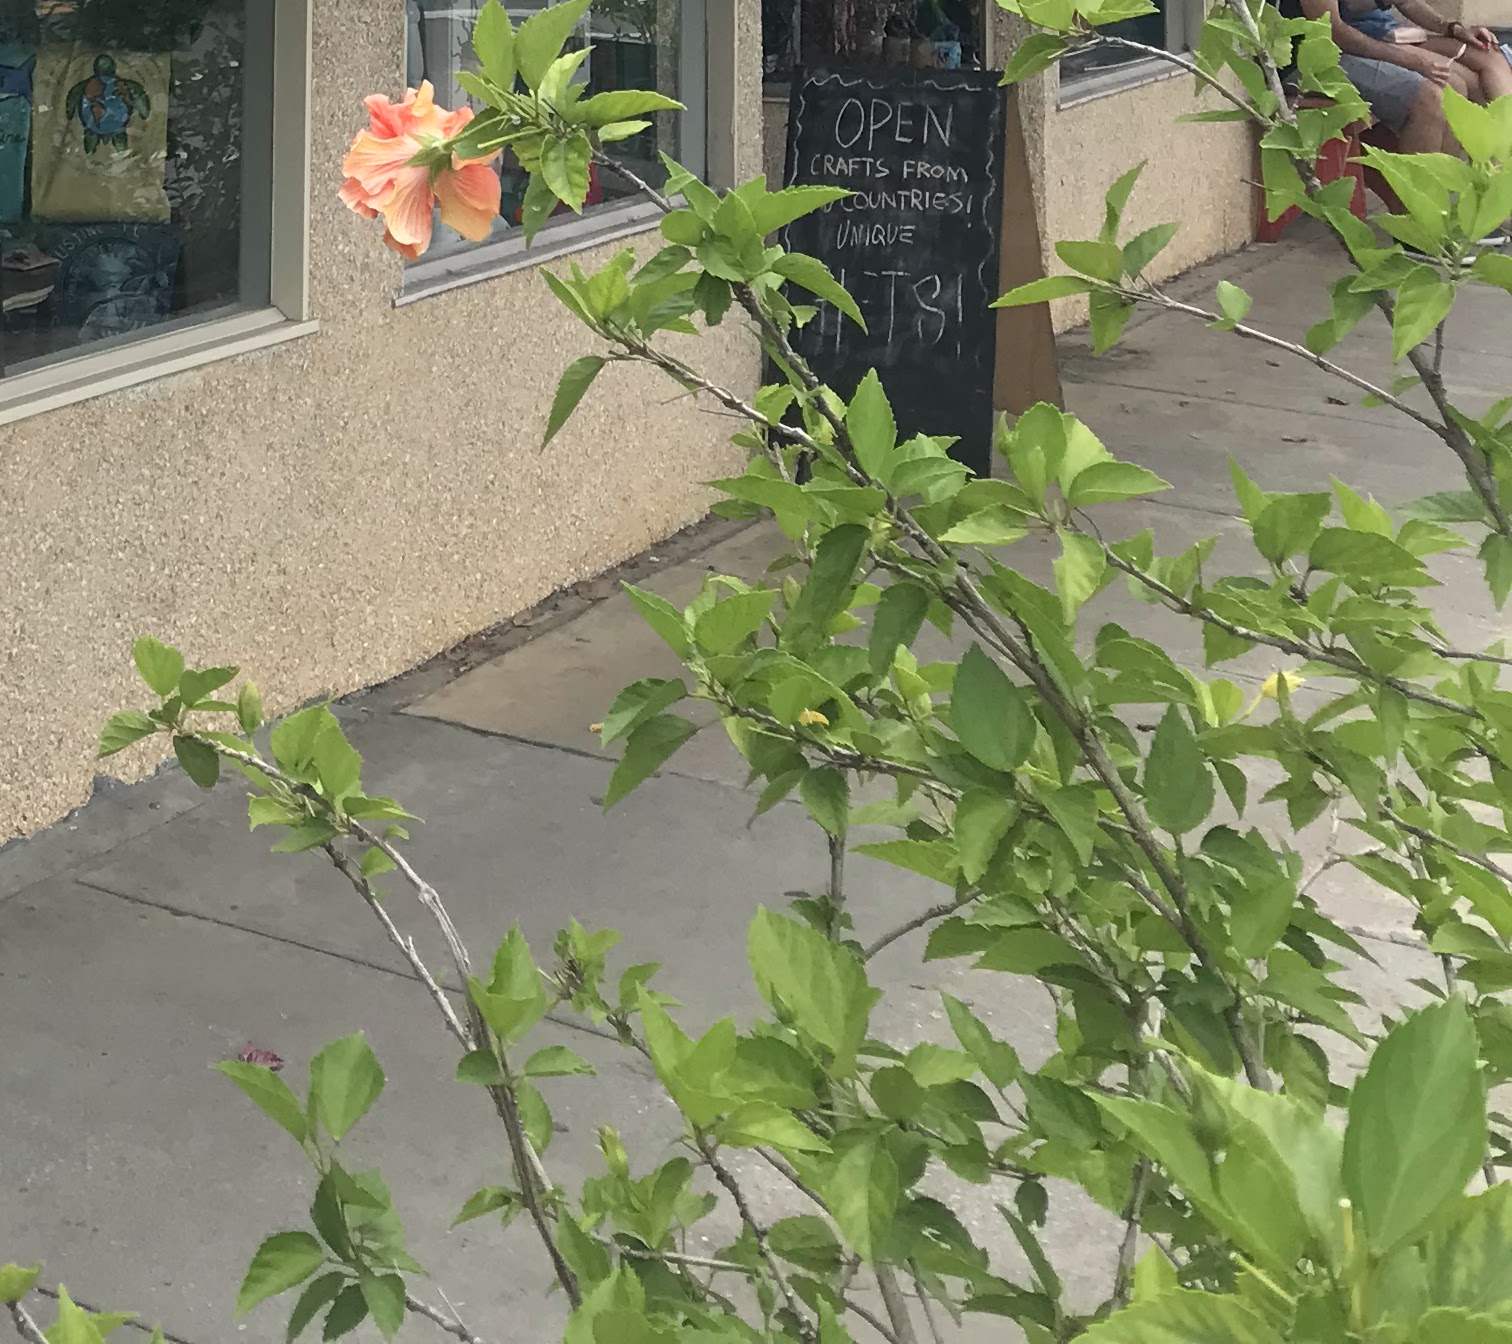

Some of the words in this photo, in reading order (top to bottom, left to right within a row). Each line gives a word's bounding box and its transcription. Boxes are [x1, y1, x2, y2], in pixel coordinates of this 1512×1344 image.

[835, 98, 954, 151] OPEN
[810, 154, 890, 178] CRAFTS
[903, 160, 968, 183] FROM
[837, 220, 917, 250] UNIQUE
